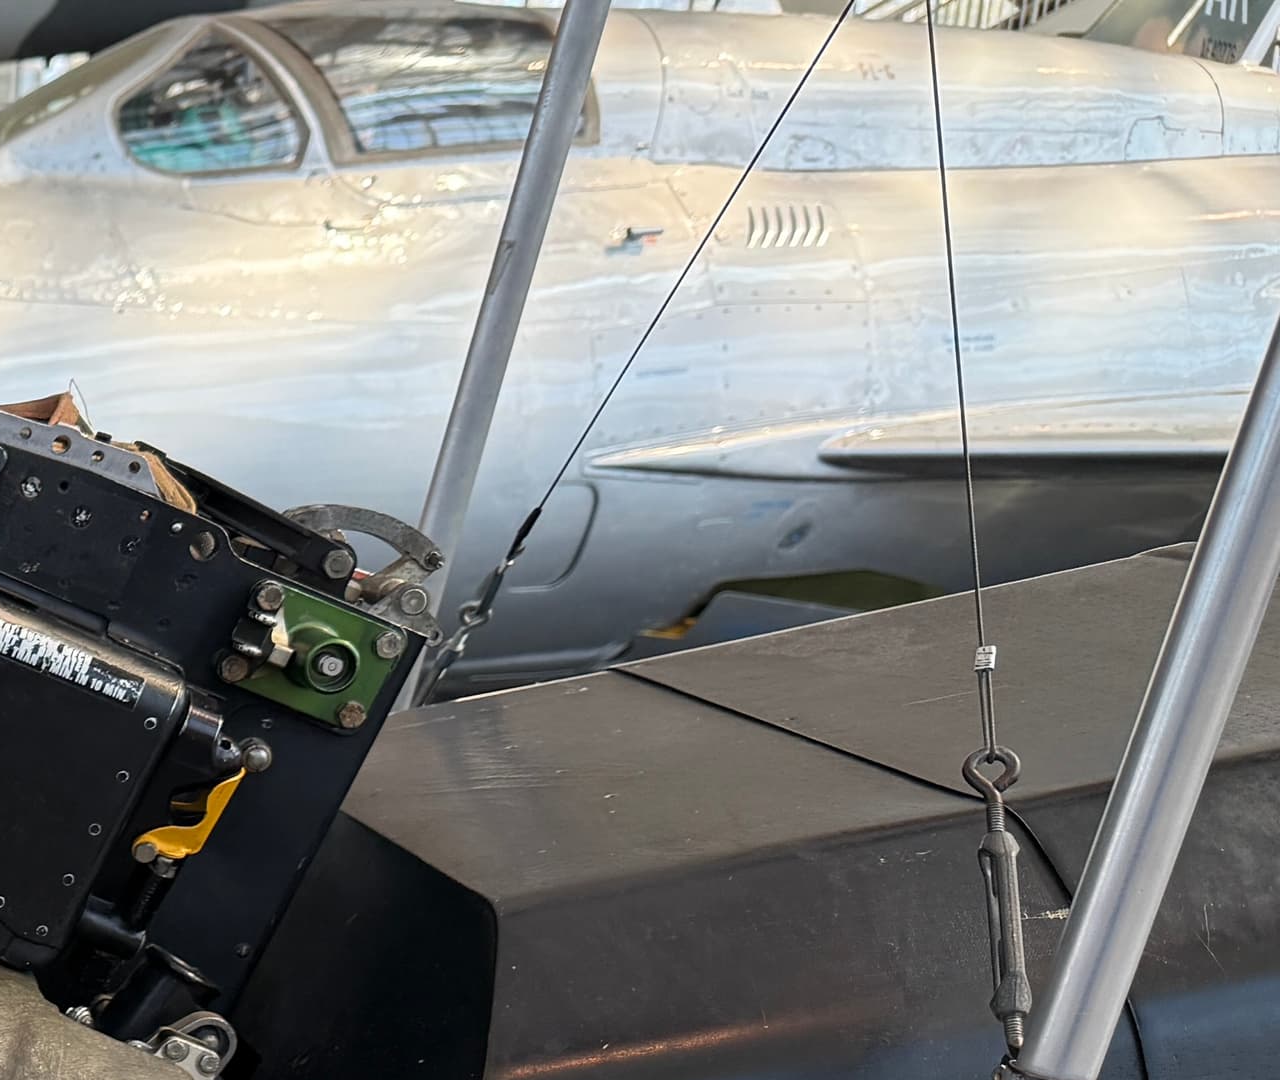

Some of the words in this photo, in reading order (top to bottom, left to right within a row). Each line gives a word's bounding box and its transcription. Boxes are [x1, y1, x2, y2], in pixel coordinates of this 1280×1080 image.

[11, 645, 39, 665] THAN
[74, 671, 89, 685] IN
[90, 677, 103, 690] 10
[102, 682, 128, 702] MIN.
